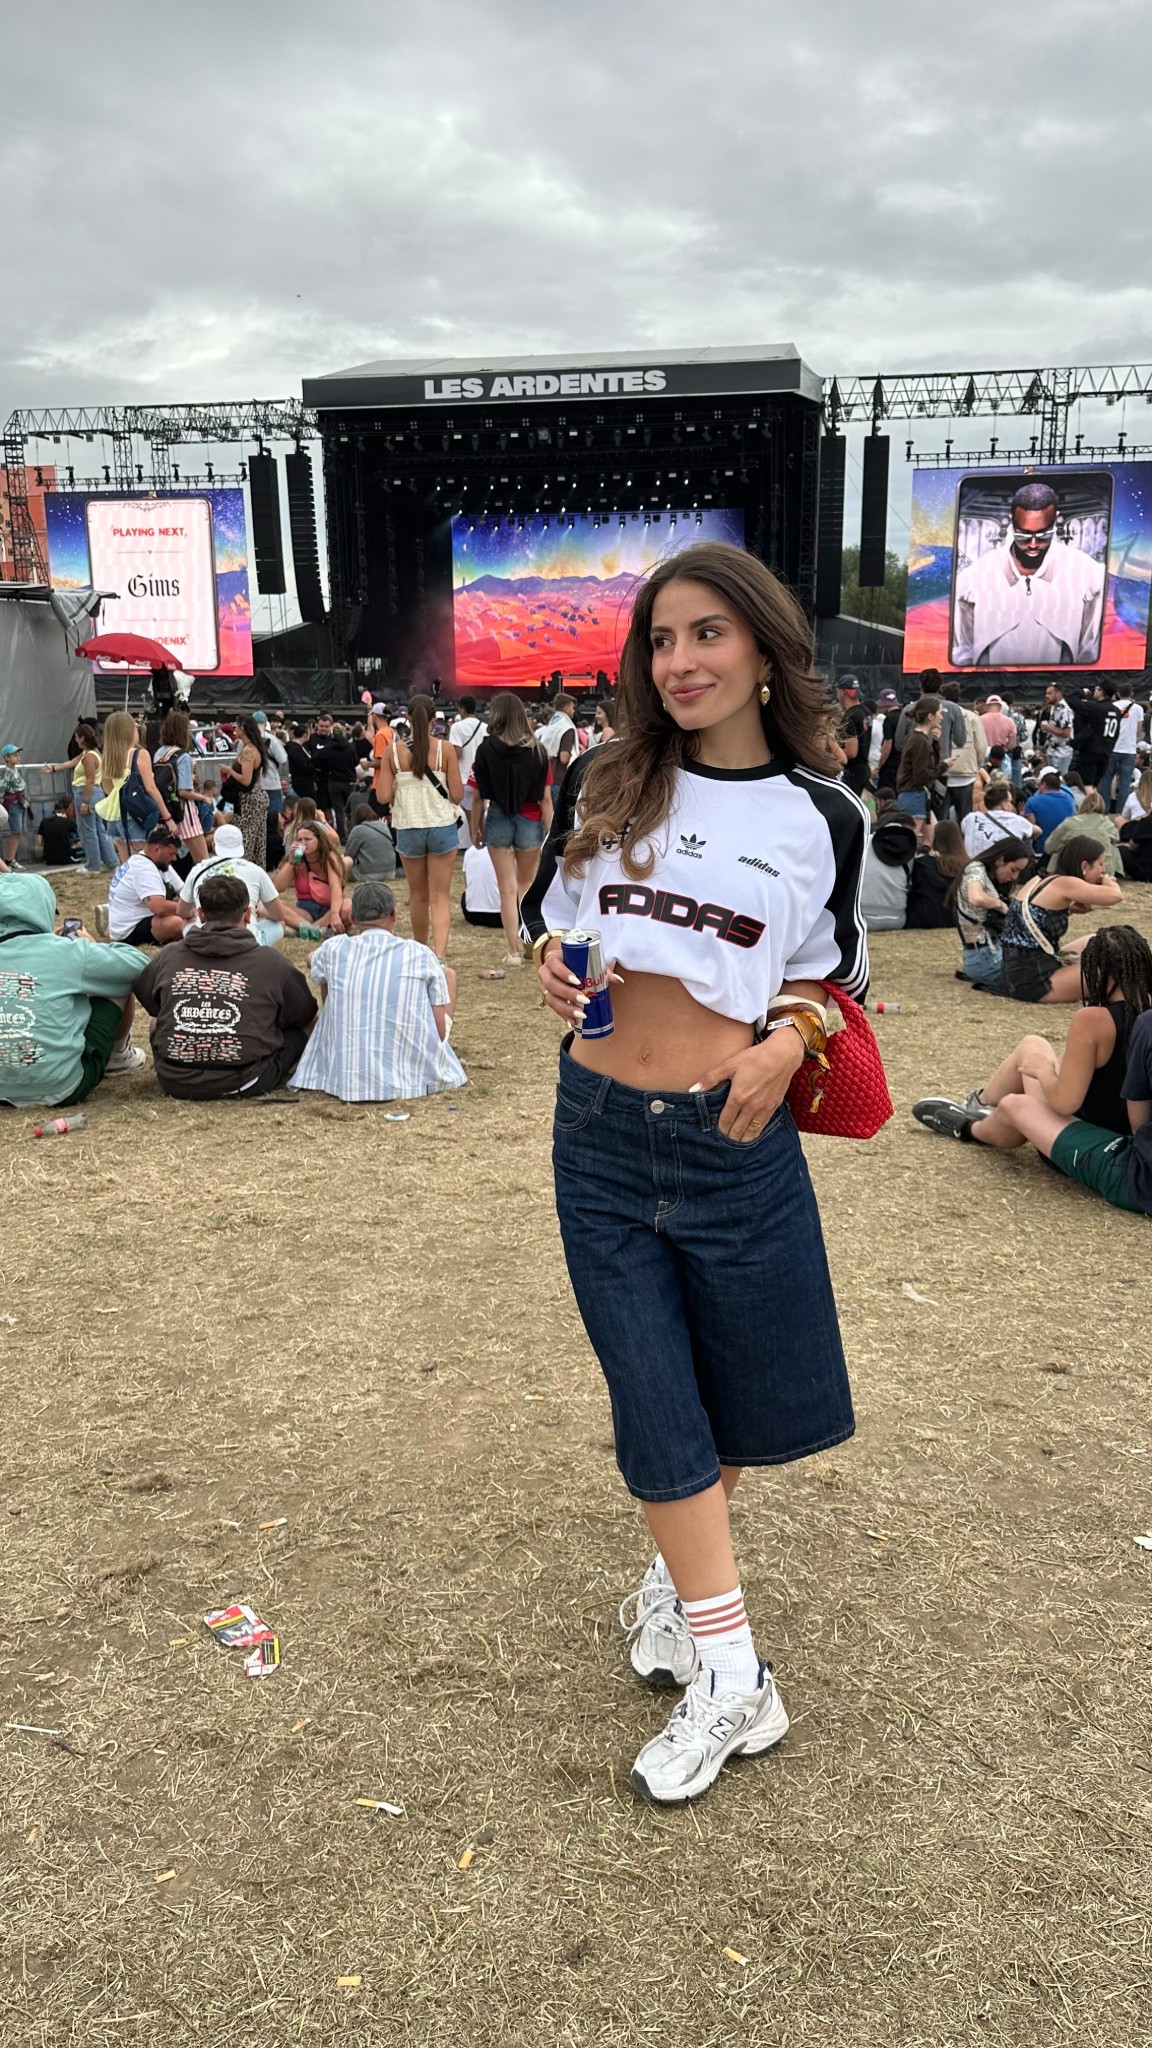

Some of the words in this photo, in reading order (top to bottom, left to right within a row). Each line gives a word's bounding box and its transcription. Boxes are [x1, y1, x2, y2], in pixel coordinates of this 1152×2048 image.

[424, 378, 485, 400] LES
[490, 370, 667, 397] ARDENTES
[127, 573, 180, 598] Gims
[151, 636, 188, 646] OENIX
[1103, 718, 1119, 738] 10
[675, 847, 704, 860] adidas
[737, 855, 781, 878] adidas
[598, 884, 767, 949] ADIDAS
[181, 1006, 232, 1021] ARDENTES
